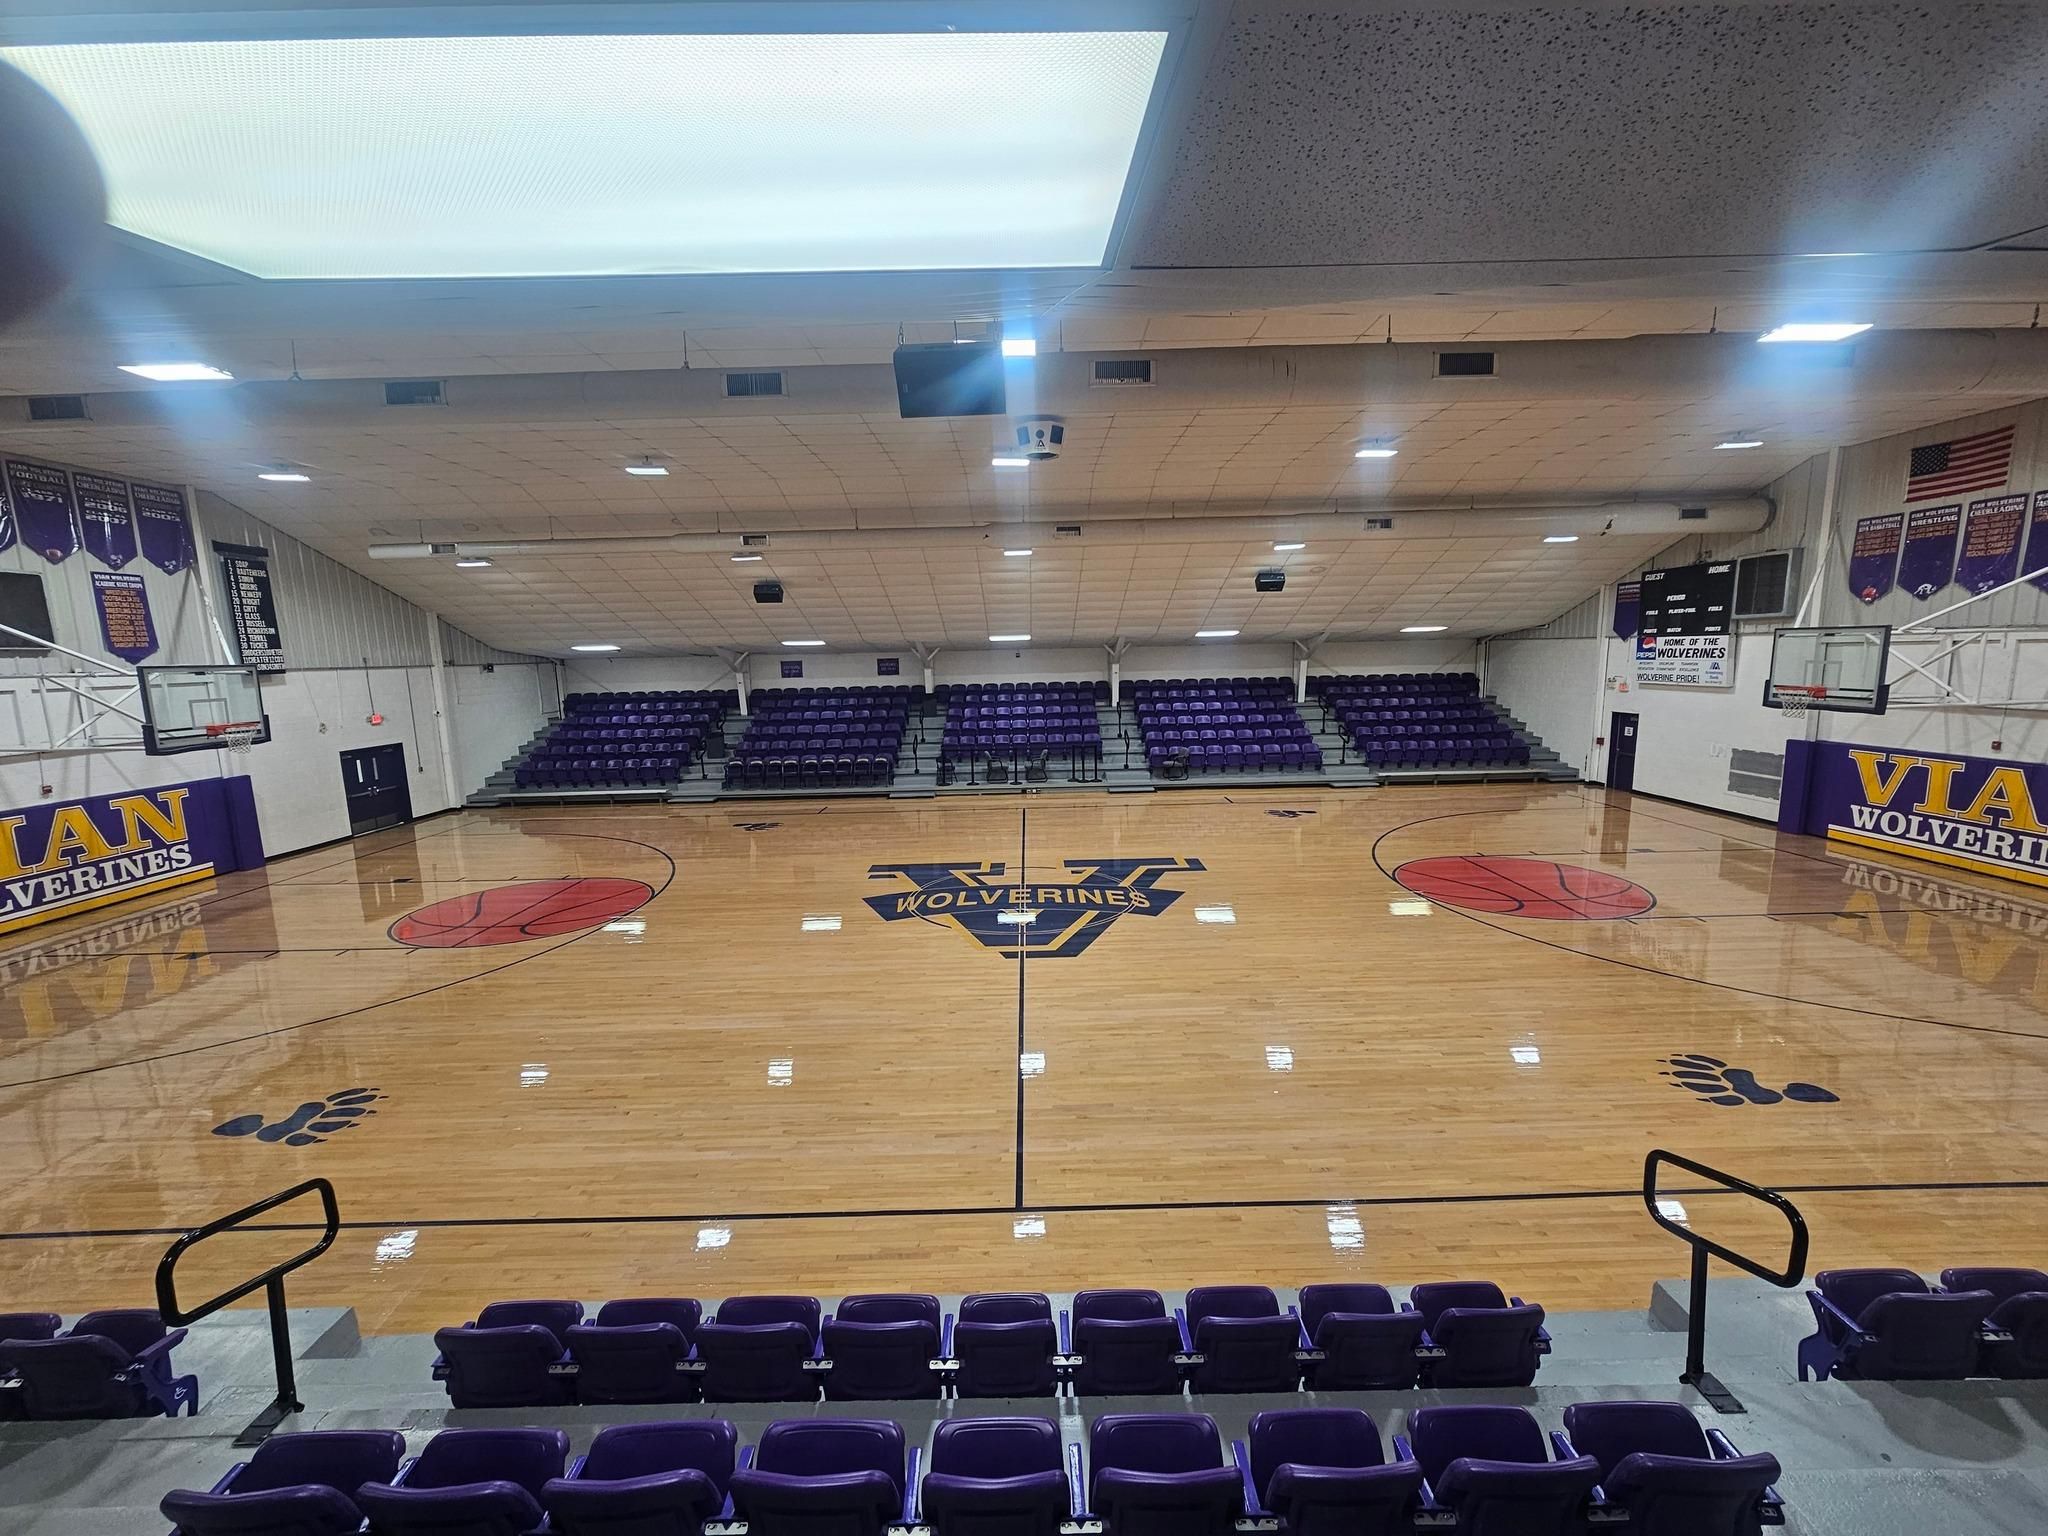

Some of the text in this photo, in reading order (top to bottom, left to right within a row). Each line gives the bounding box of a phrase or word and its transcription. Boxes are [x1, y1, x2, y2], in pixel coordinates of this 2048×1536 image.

[10, 469, 65, 485] FOOTBALL
[1969, 504, 2025, 517] CHEERLEADING
[1911, 514, 1958, 527] WRESTLING
[1645, 565, 1731, 581] GUEST HOME
[235, 612, 242, 620] 22
[1664, 637, 1720, 646] HOME OF THE
[1657, 647, 1726, 659] WOLVERINES
[1637, 672, 1673, 681] WOLVERINE
[1676, 674, 1700, 683] PRIDE!
[896, 887, 1151, 913] WOLVERINES
